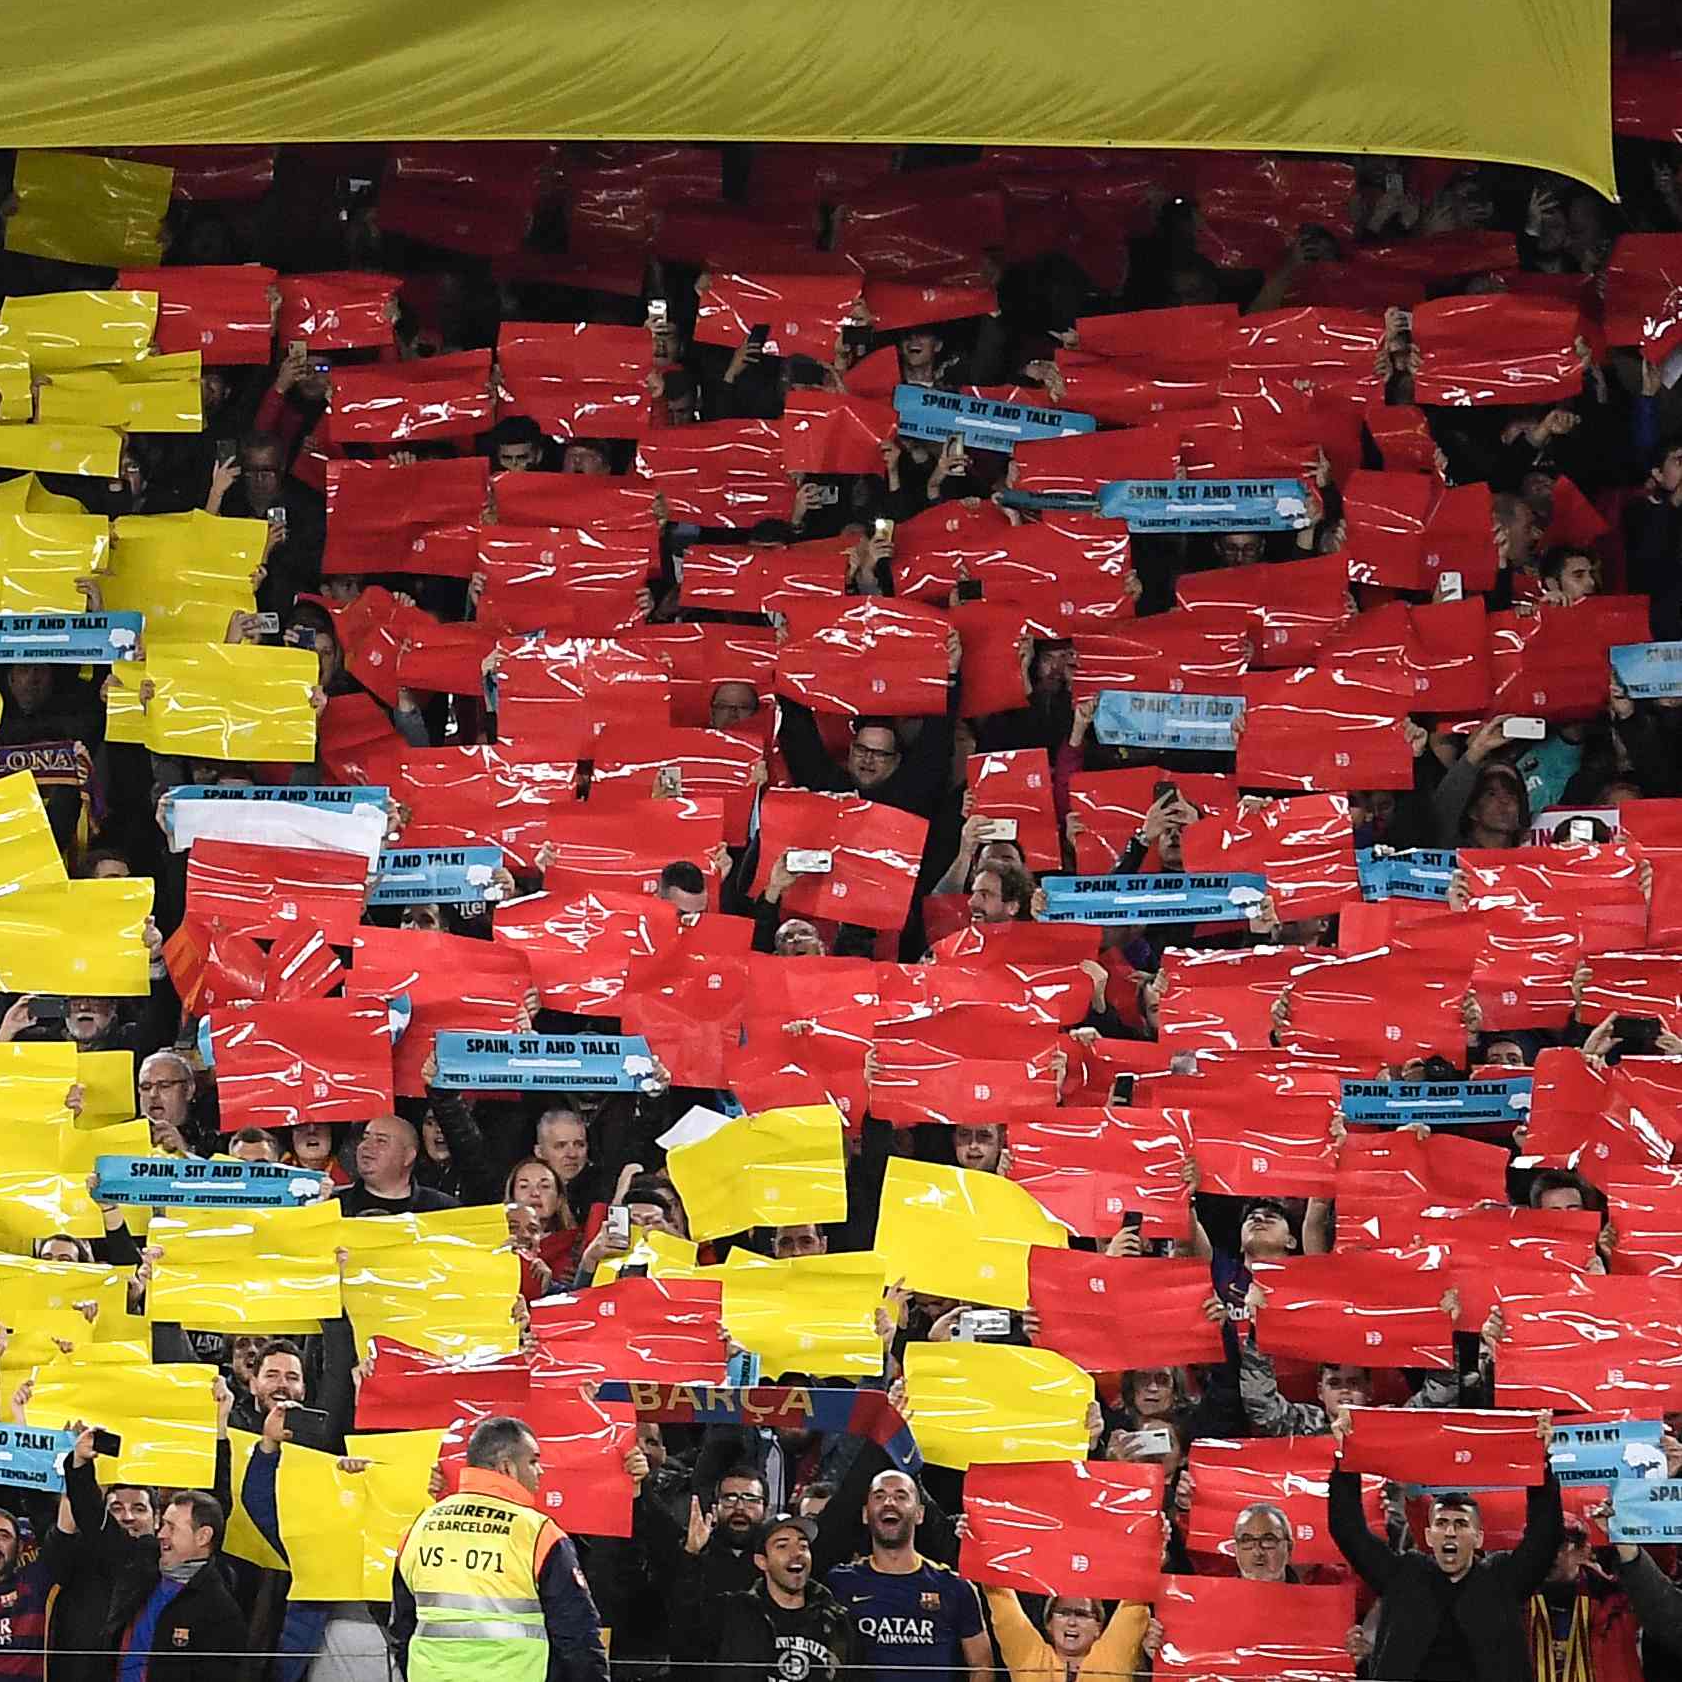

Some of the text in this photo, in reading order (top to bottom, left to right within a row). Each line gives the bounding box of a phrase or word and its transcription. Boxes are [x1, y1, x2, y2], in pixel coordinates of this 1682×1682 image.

[922, 393, 1062, 427] SPAIN, SIT AND TALK!
[1128, 484, 1274, 500] SPAIN, SIT AND TALK!
[12, 618, 33, 632] SIT
[37, 618, 66, 631] AND
[71, 617, 109, 630] TALK!
[203, 788, 353, 803] SPAIN, SIT AND TALK!
[392, 852, 466, 869] AND TALK!
[1073, 875, 1229, 894] SPAIN, SIT AND TALK!
[466, 1038, 621, 1056] SPAIN, SIT AND TALK!
[1342, 1083, 1507, 1100] SPAIN, SIT AND TALK!
[130, 1161, 290, 1180] SPAIN, SIT AND TALK!
[629, 1383, 814, 1424] BARÇA
[14, 1435, 55, 1452] TALK!
[1575, 1429, 1621, 1445] TALK!
[429, 1503, 519, 1524] SEGURETAT
[419, 1546, 445, 1568] VS
[465, 1548, 505, 1574] 071
[857, 1616, 935, 1638] QATAR
